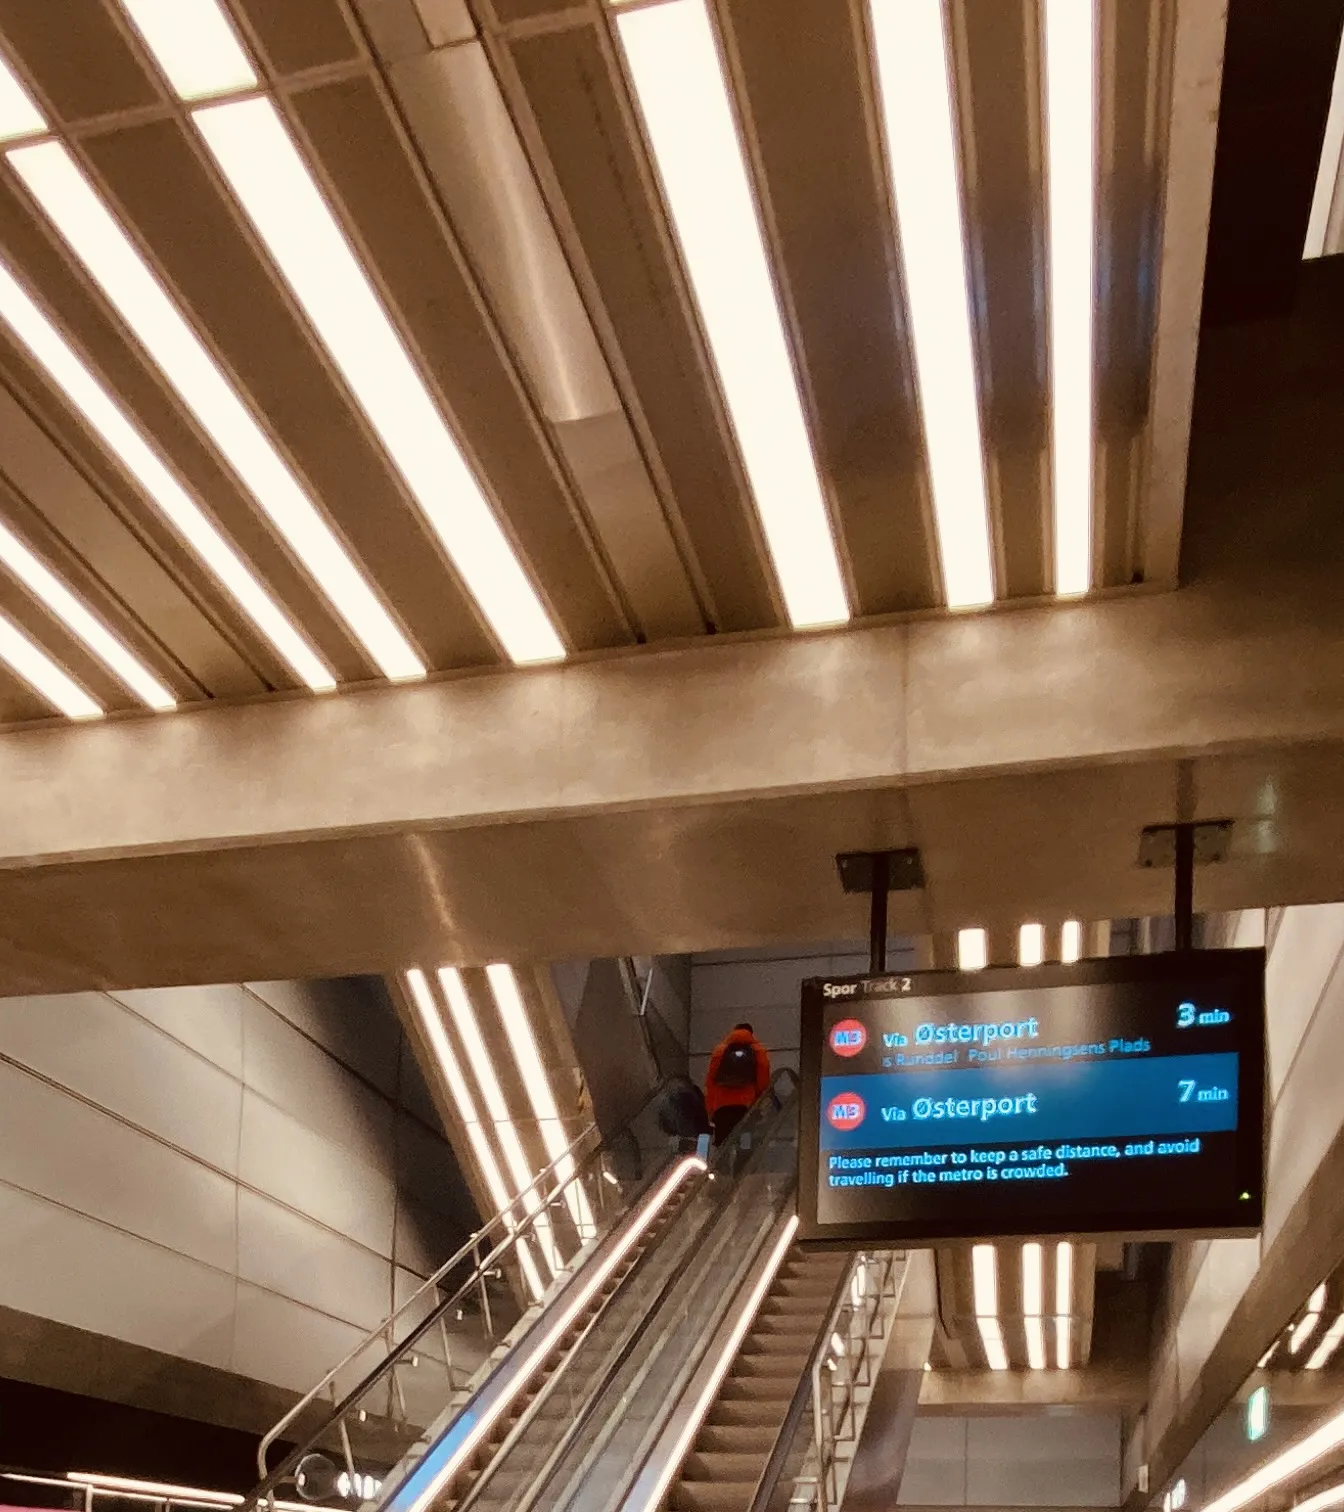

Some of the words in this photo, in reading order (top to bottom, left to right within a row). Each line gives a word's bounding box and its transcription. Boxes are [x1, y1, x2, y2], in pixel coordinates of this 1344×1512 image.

[823, 983, 856, 997] Spor
[862, 979, 896, 993] Track
[902, 978, 911, 991] 2
[834, 1030, 862, 1045] M3
[883, 1033, 908, 1047] Via
[915, 1017, 1038, 1046] Østerport
[1177, 1003, 1195, 1028] 3
[1199, 1009, 1230, 1024] min
[969, 1045, 1001, 1061] Poul
[1008, 1042, 1105, 1060] Henningsens
[1108, 1038, 1151, 1053] Plads
[832, 1104, 860, 1119] M3
[881, 1107, 905, 1121] Via
[913, 1093, 1037, 1121] Østerport
[1178, 1080, 1195, 1102] 7
[1197, 1086, 1229, 1101] min
[829, 1156, 871, 1169] Please
[875, 1152, 947, 1168] remember
[951, 1152, 967, 1164] to
[971, 1149, 1005, 1165] keep
[1009, 1151, 1019, 1161] a
[1021, 1145, 1052, 1160] safe
[1056, 1145, 1121, 1159] distance,
[1124, 1140, 1153, 1155] and
[1158, 1138, 1200, 1153] avoid
[829, 1172, 894, 1188] travelling
[898, 1170, 909, 1183] if
[912, 1169, 936, 1182] the
[940, 1168, 983, 1181] metro
[986, 1166, 997, 1179] is
[1001, 1162, 1069, 1179] crowded.
